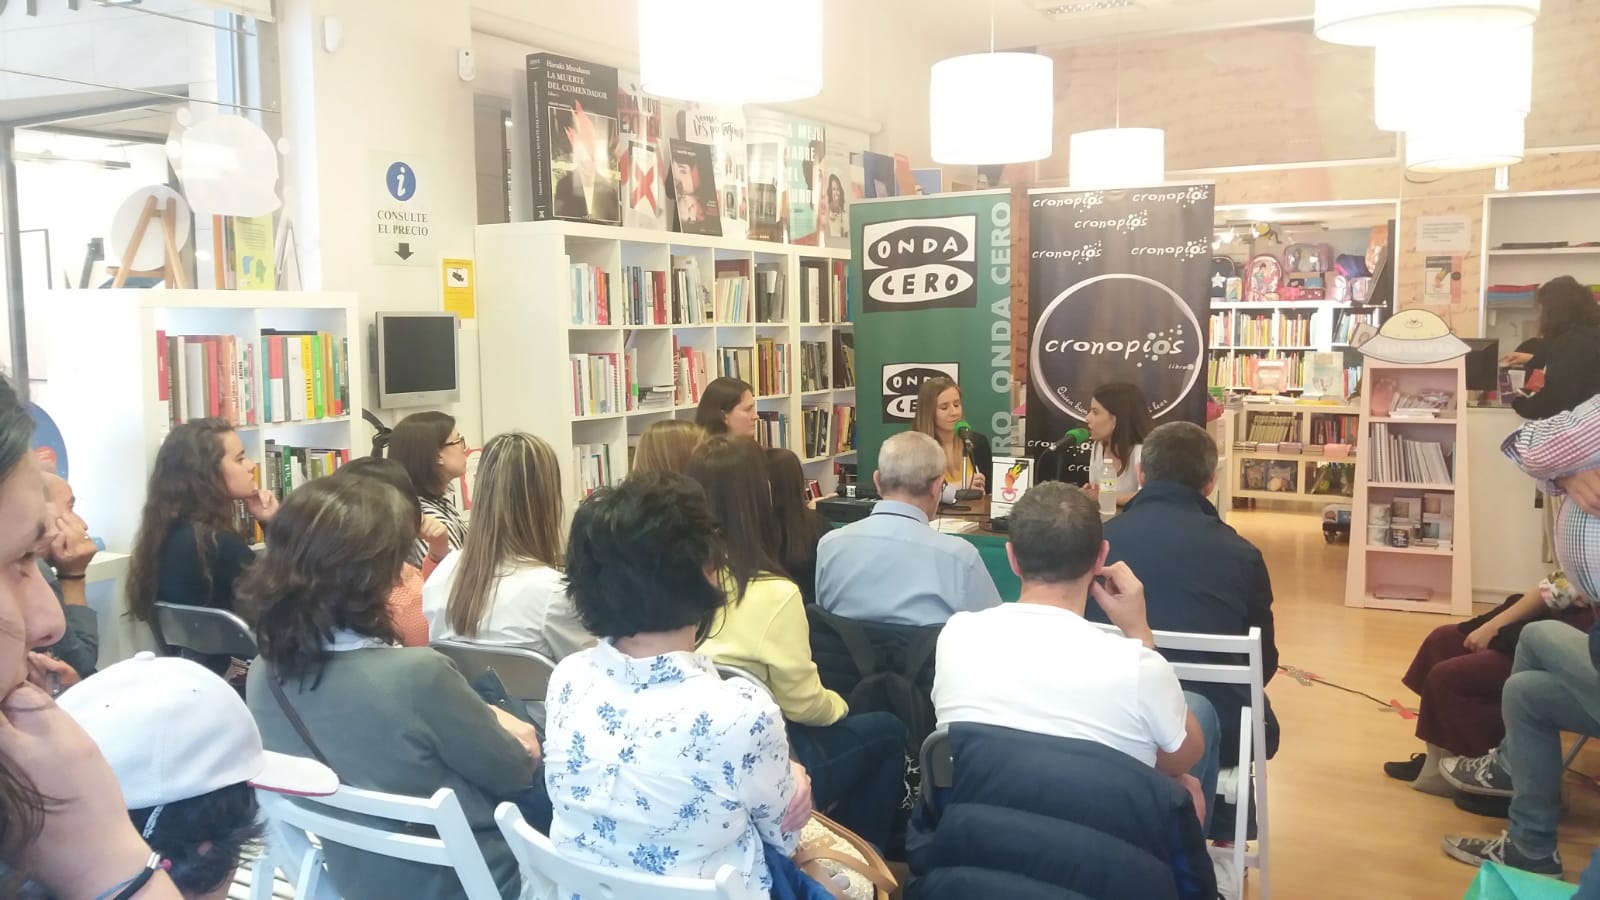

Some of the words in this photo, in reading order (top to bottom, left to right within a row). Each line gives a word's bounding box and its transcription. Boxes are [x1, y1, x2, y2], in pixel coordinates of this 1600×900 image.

[546, 70, 556, 79] LA
[557, 73, 585, 84] MUERTE
[547, 80, 561, 91] DEL
[562, 85, 608, 99] COMENDADOR
[1032, 192, 1104, 209] cronopios
[1132, 186, 1208, 204] cronopios
[377, 209, 428, 223] CONSULTE
[1074, 214, 1148, 231] cronopios
[378, 224, 391, 234] EL
[393, 224, 429, 236] PRECIO
[877, 236, 958, 259] ONDA
[990, 201, 1011, 285] CERO
[1131, 241, 1208, 258] cronopios
[1032, 245, 1102, 261] cronopios
[882, 272, 959, 296] CERO
[990, 296, 1011, 393] ONDA
[1044, 333, 1185, 360] cronopios
[896, 399, 918, 413] CE
[991, 411, 1011, 454] RO
